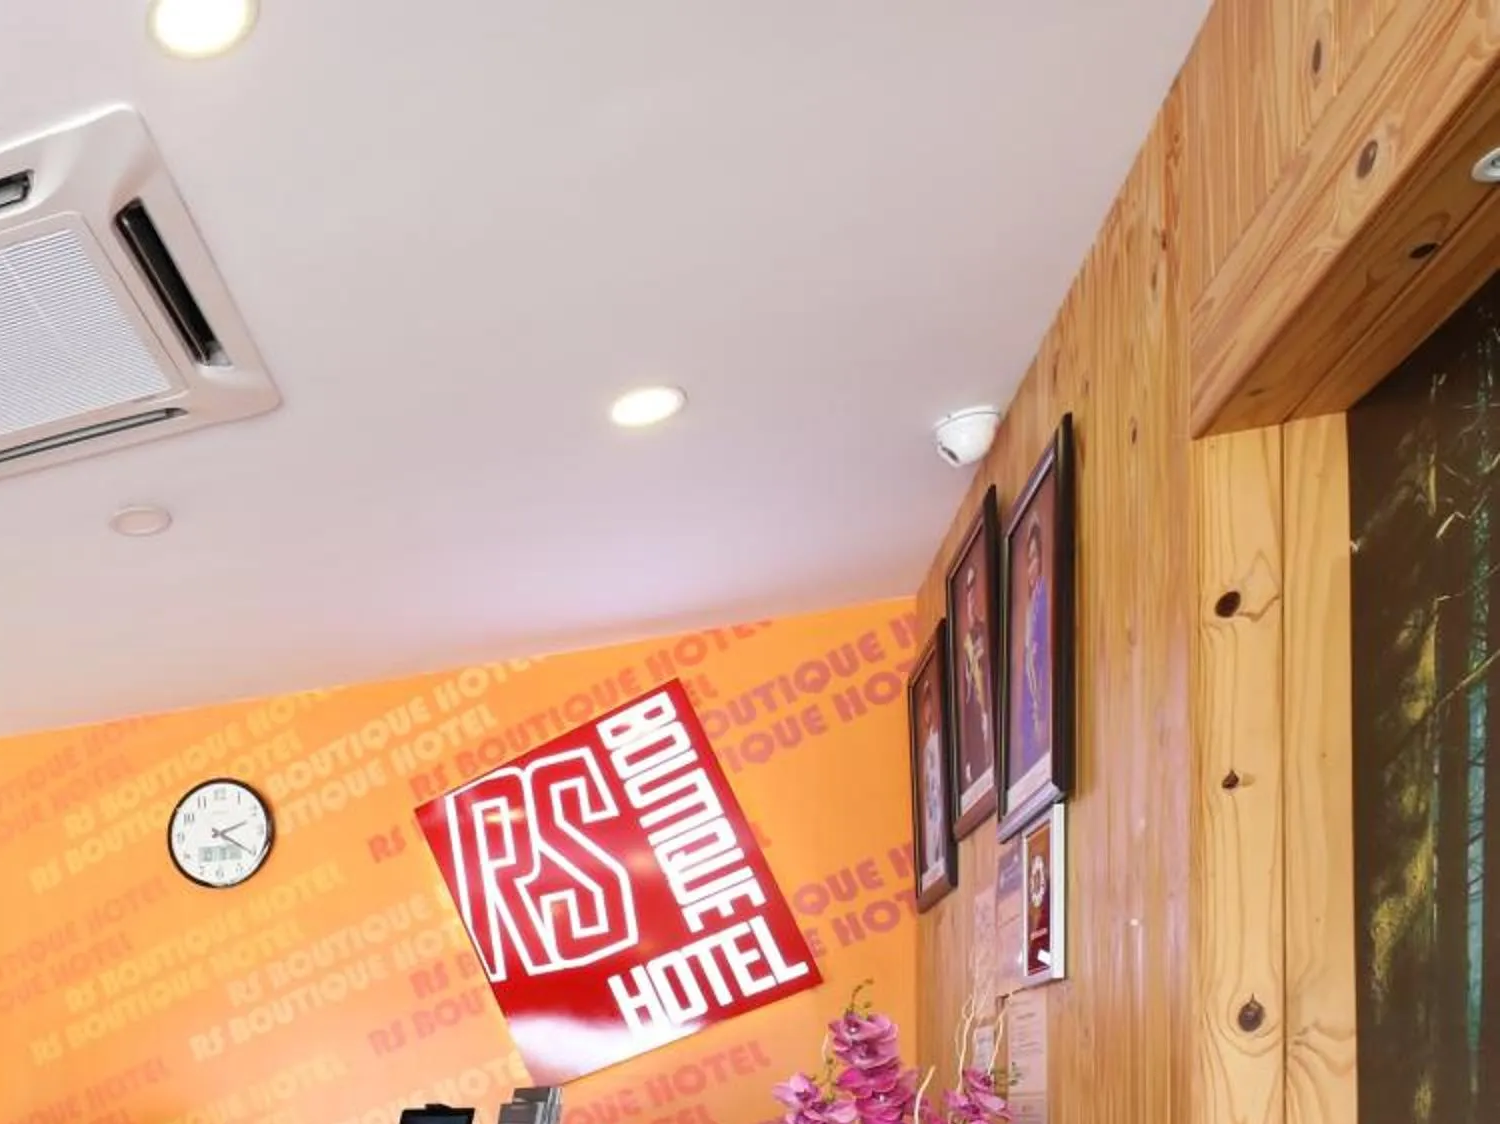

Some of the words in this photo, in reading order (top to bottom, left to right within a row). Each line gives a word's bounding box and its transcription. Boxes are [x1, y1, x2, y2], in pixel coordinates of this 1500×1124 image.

[408, 762, 448, 800] RS
[452, 667, 639, 772] BOUTIQUE
[701, 630, 886, 740] OUTIQUE
[100, 722, 244, 821] BOUTIQUE
[265, 696, 432, 800] BOUTIQUE
[390, 703, 498, 777] HOTEL
[64, 802, 170, 875] BOUTIQ
[222, 728, 302, 779] OTEL
[367, 825, 407, 864] RS
[596, 691, 766, 933] BOUTIQUE
[445, 746, 638, 980] RS
[99, 908, 246, 996] BOUTIQUE
[247, 860, 348, 921] HOTEL
[266, 892, 432, 990] BOUTIQUE
[607, 915, 809, 1036] HOTEL
[66, 962, 209, 1050] BOUTIQUE
[209, 920, 305, 978] HOTEL
[229, 954, 389, 1043] BOUTIQUE
[430, 1050, 530, 1104] HOTE
[645, 1040, 771, 1107] HOTEL
